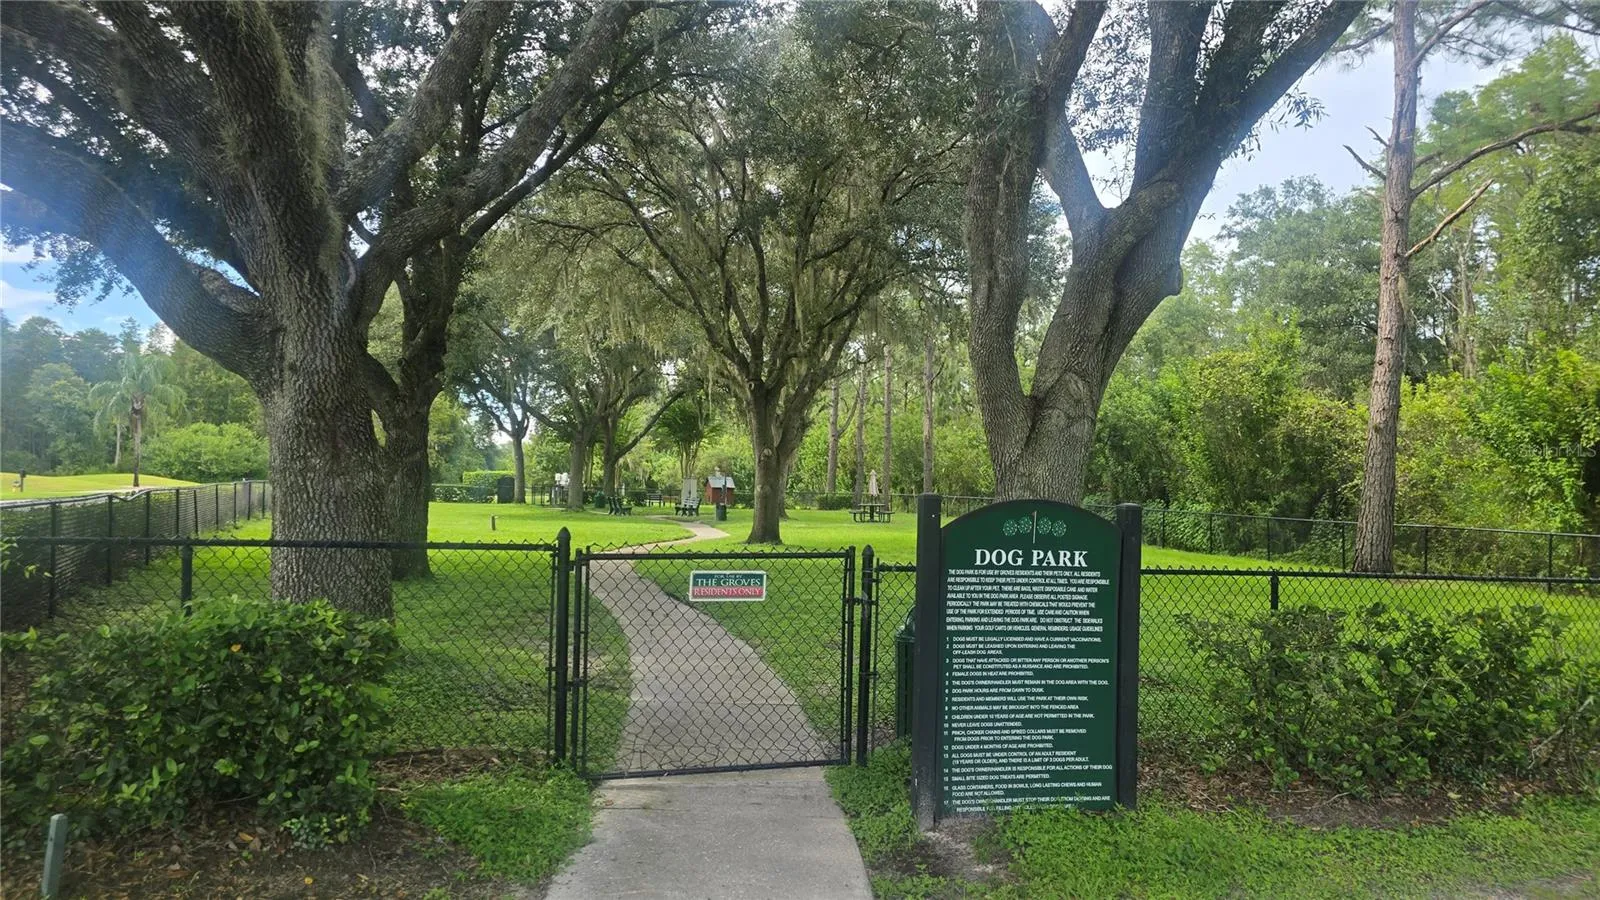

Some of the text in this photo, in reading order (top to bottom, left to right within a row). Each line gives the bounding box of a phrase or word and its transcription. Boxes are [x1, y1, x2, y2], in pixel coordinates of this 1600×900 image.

[974, 549, 1088, 567] DOG PARK
[696, 578, 761, 586] THE GROVES
[694, 587, 761, 596] RESIDENTS ONLY
